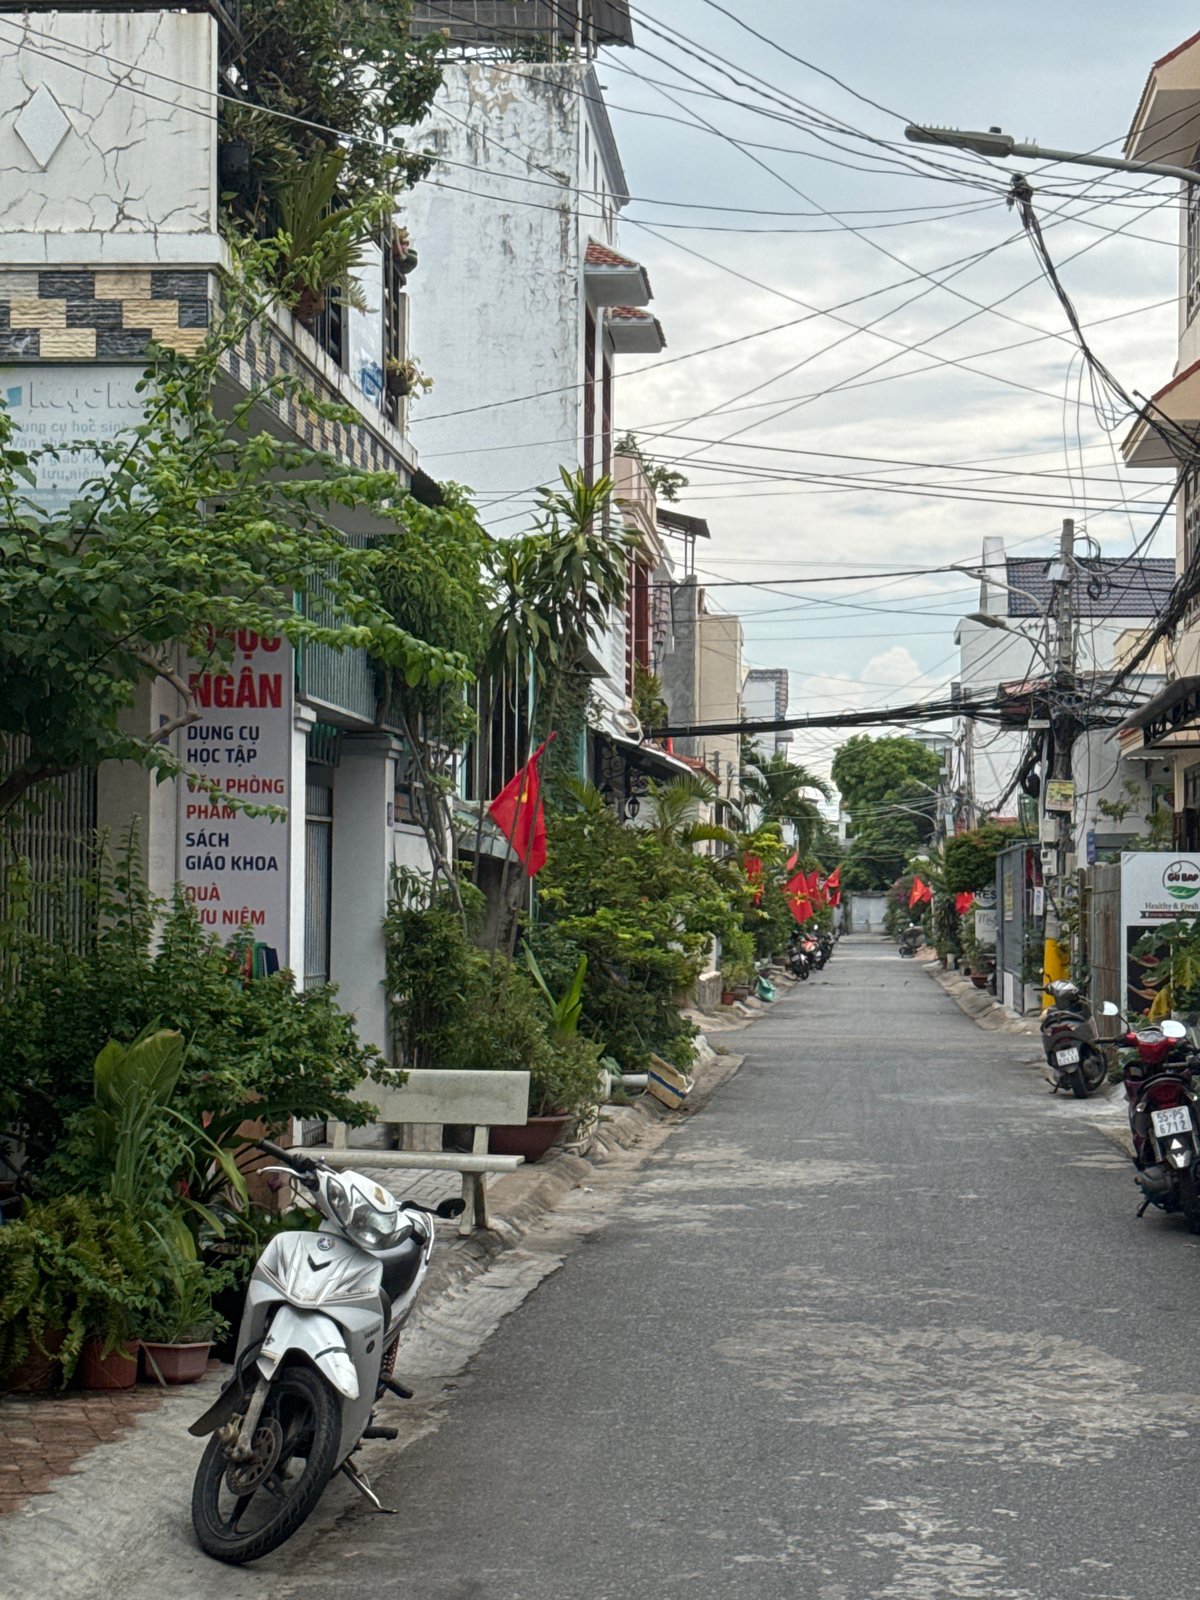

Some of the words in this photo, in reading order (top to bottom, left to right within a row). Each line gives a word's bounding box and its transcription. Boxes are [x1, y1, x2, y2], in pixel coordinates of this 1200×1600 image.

[188, 665, 282, 708] NGÂN
[187, 725, 234, 745] DỤNG
[239, 725, 260, 745] CỤ
[187, 748, 220, 767] HỌC
[225, 744, 258, 767] TẬP
[226, 774, 285, 794] PHÒNG
[185, 828, 230, 848] SÁCH
[185, 851, 226, 871] GIÁO
[231, 855, 279, 872] KHOA
[185, 882, 221, 902] QUÀ
[1144, 902, 1172, 911] Healthy
[1173, 902, 1179, 910] &
[1180, 902, 1199, 910] Fresh
[1159, 1119, 1187, 1134] 6712
